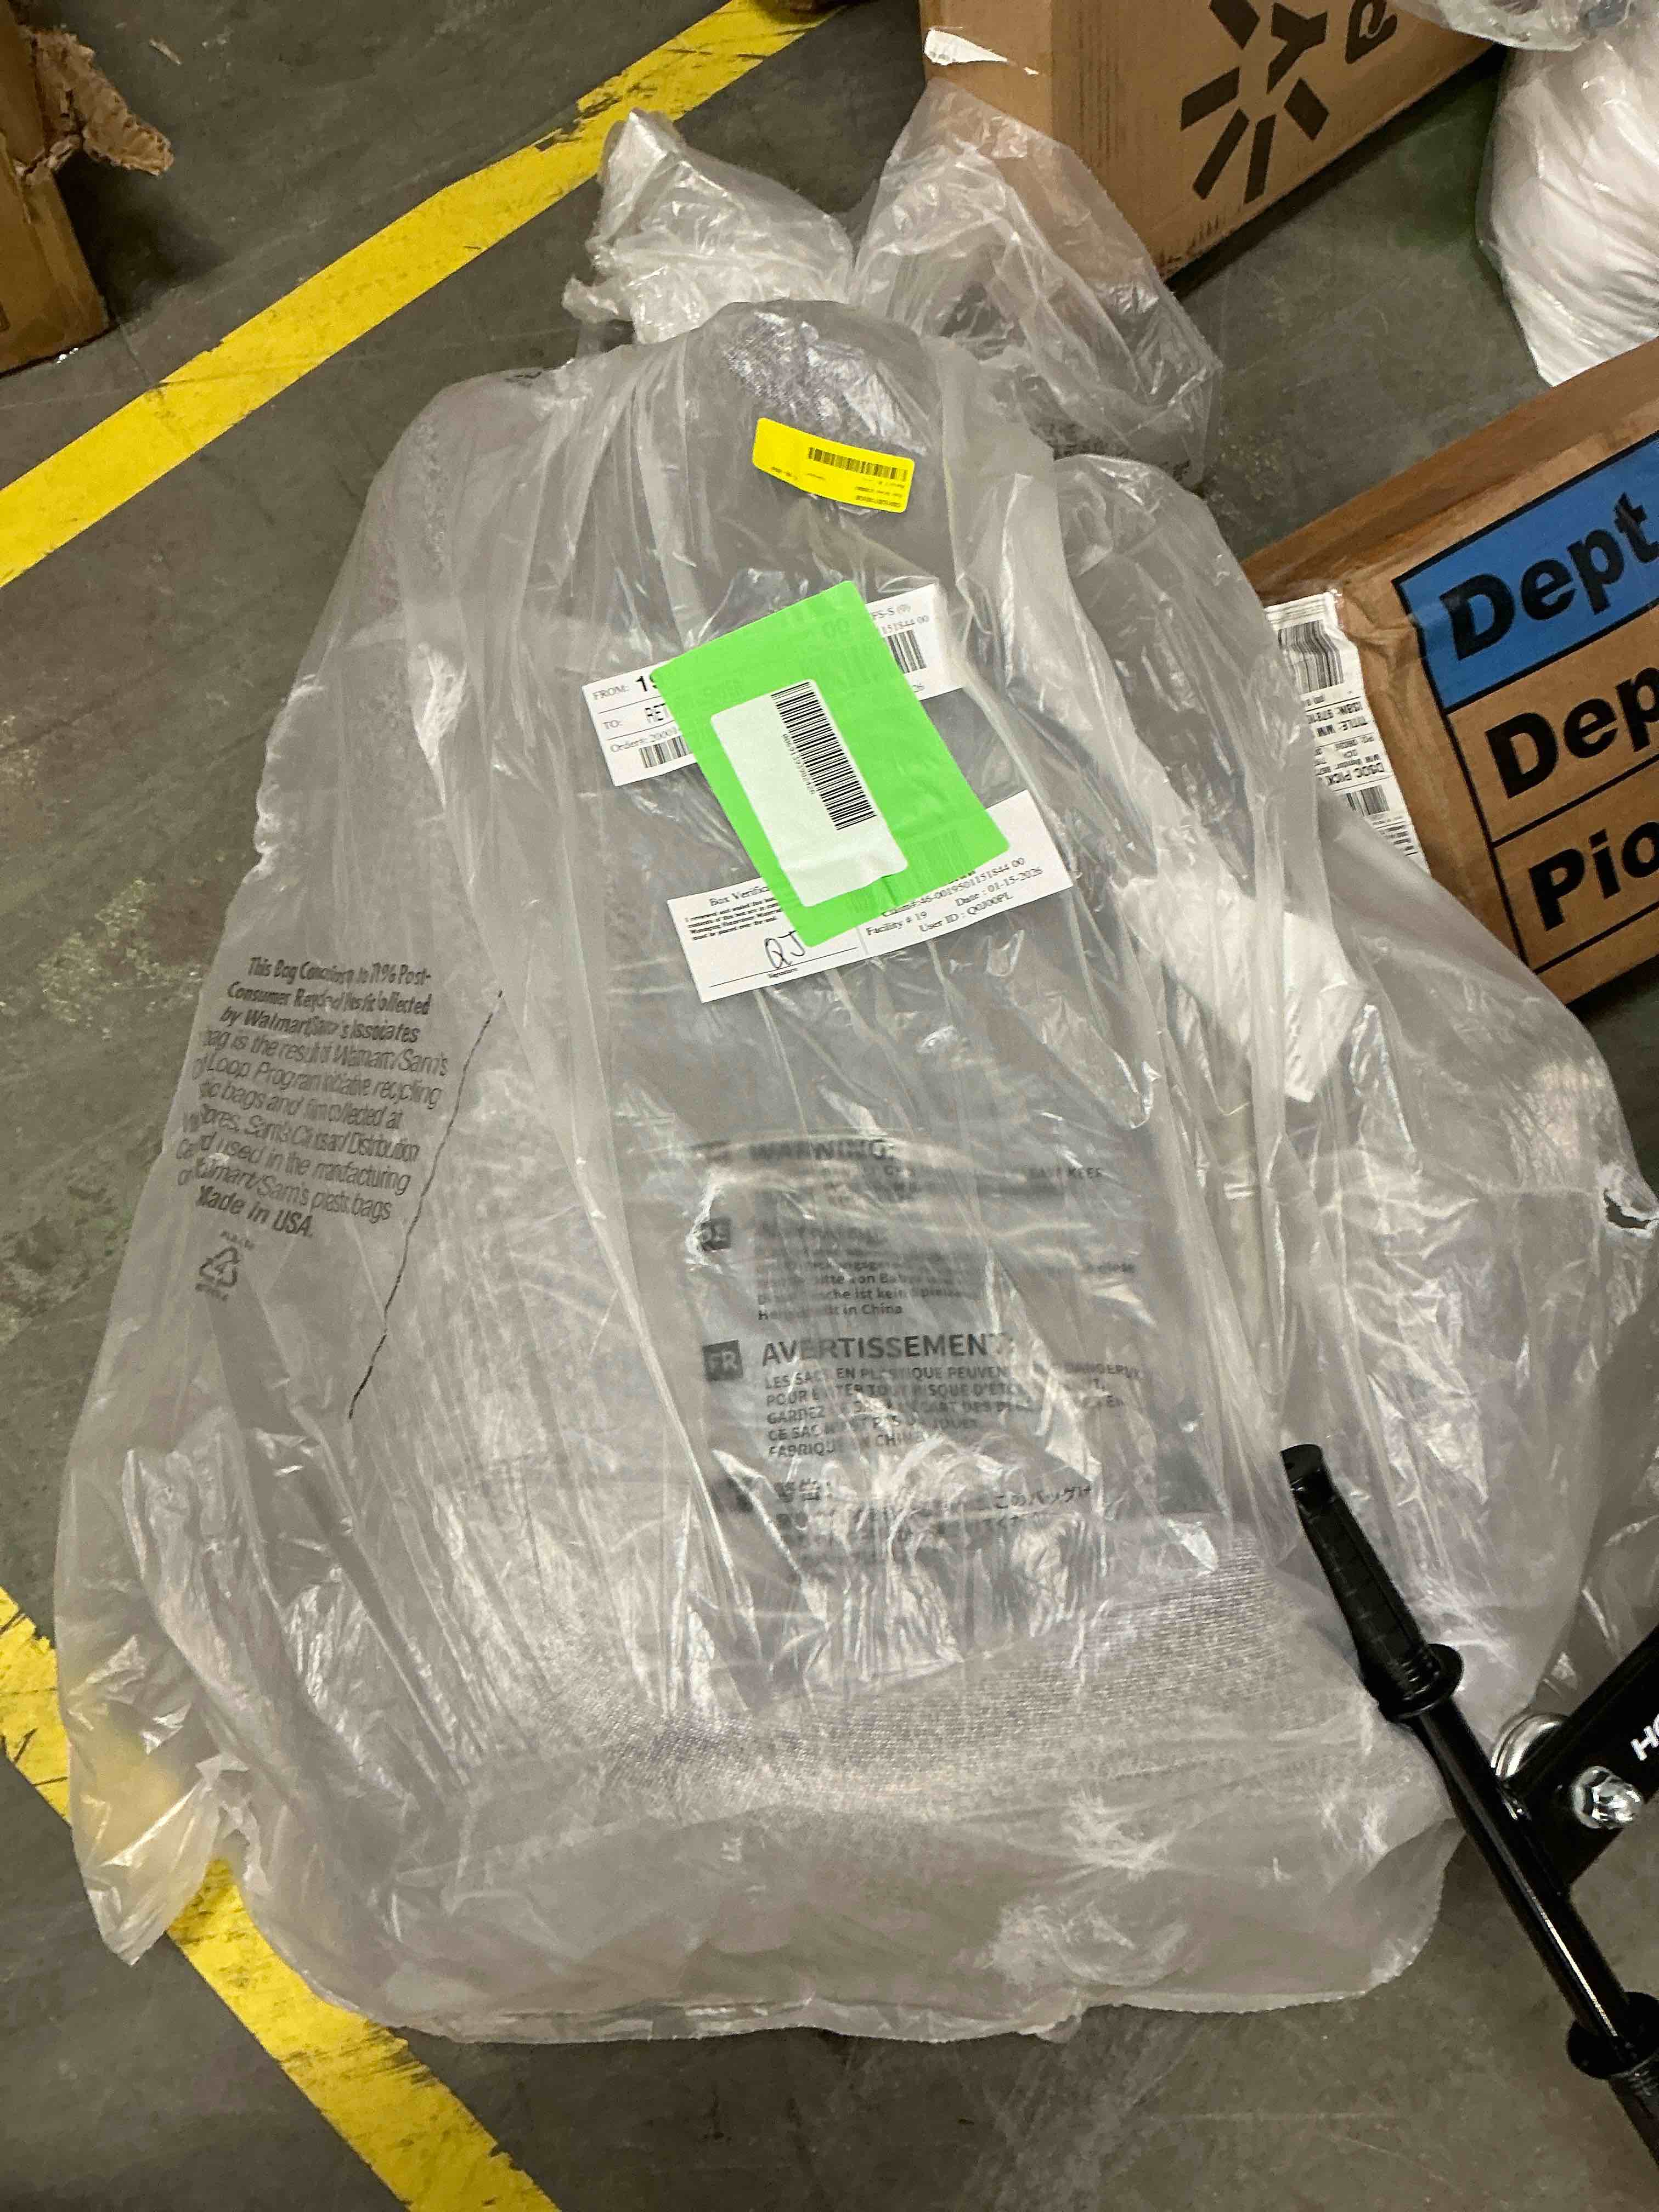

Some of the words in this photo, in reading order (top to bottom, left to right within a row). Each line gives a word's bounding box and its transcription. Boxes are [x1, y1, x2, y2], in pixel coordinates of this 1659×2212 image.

[1440, 492, 1659, 661] Dept
[709, 897, 730, 906] Box
[866, 921, 904, 935] Facility
[915, 911, 928, 922] 19
[955, 892, 980, 906] Date
[918, 920, 943, 932] User
[944, 913, 960, 924] ID
[248, 956, 272, 977] This
[274, 959, 298, 985] Bag
[219, 1006, 243, 1027] by
[250, 1035, 279, 1057] the
[221, 1081, 267, 1111] bags
[285, 1150, 312, 1176] the
[246, 1201, 270, 1225] in
[351, 1193, 393, 1224] bags
